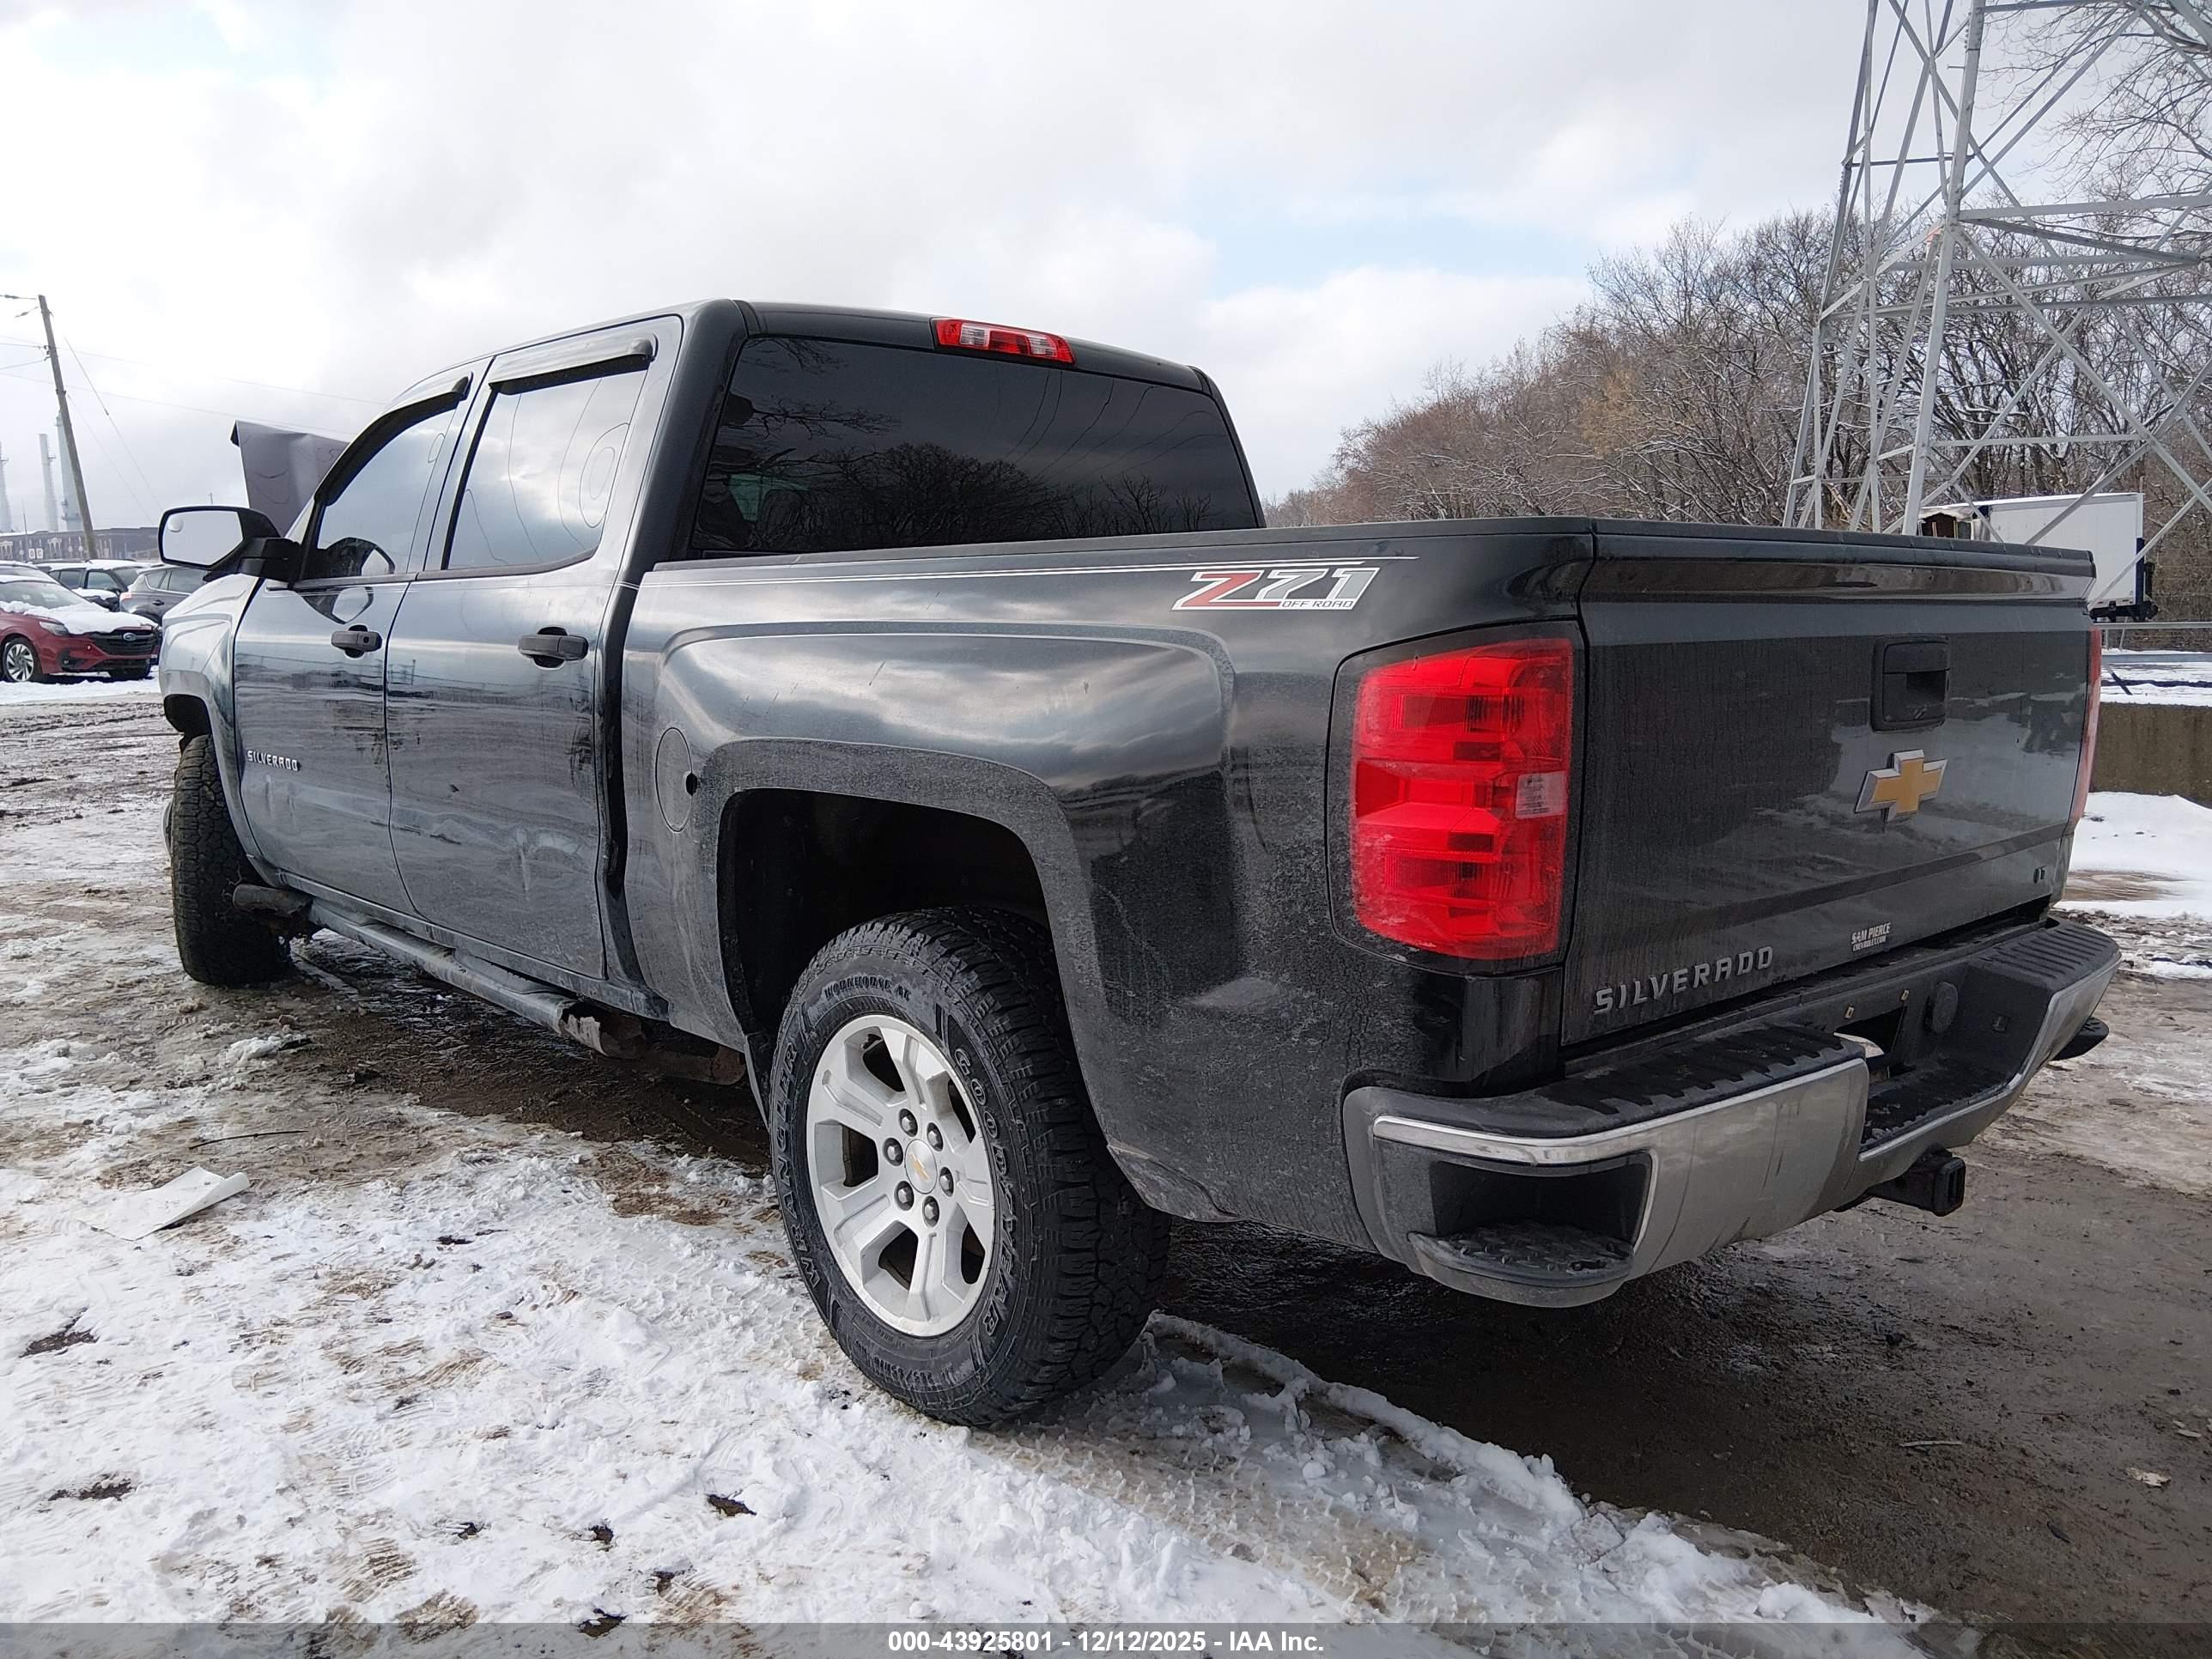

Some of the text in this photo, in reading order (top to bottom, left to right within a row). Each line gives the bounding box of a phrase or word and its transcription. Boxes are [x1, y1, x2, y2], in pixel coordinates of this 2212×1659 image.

[1171, 567, 1380, 611] Z71
[246, 750, 299, 772] SILVERADO
[1850, 922, 1892, 945] SAM PIERCE
[1593, 945, 1773, 1016] SILVERADO
[776, 1041, 821, 1289] WRANGLER
[954, 1048, 1014, 1336] GOODYEAR
